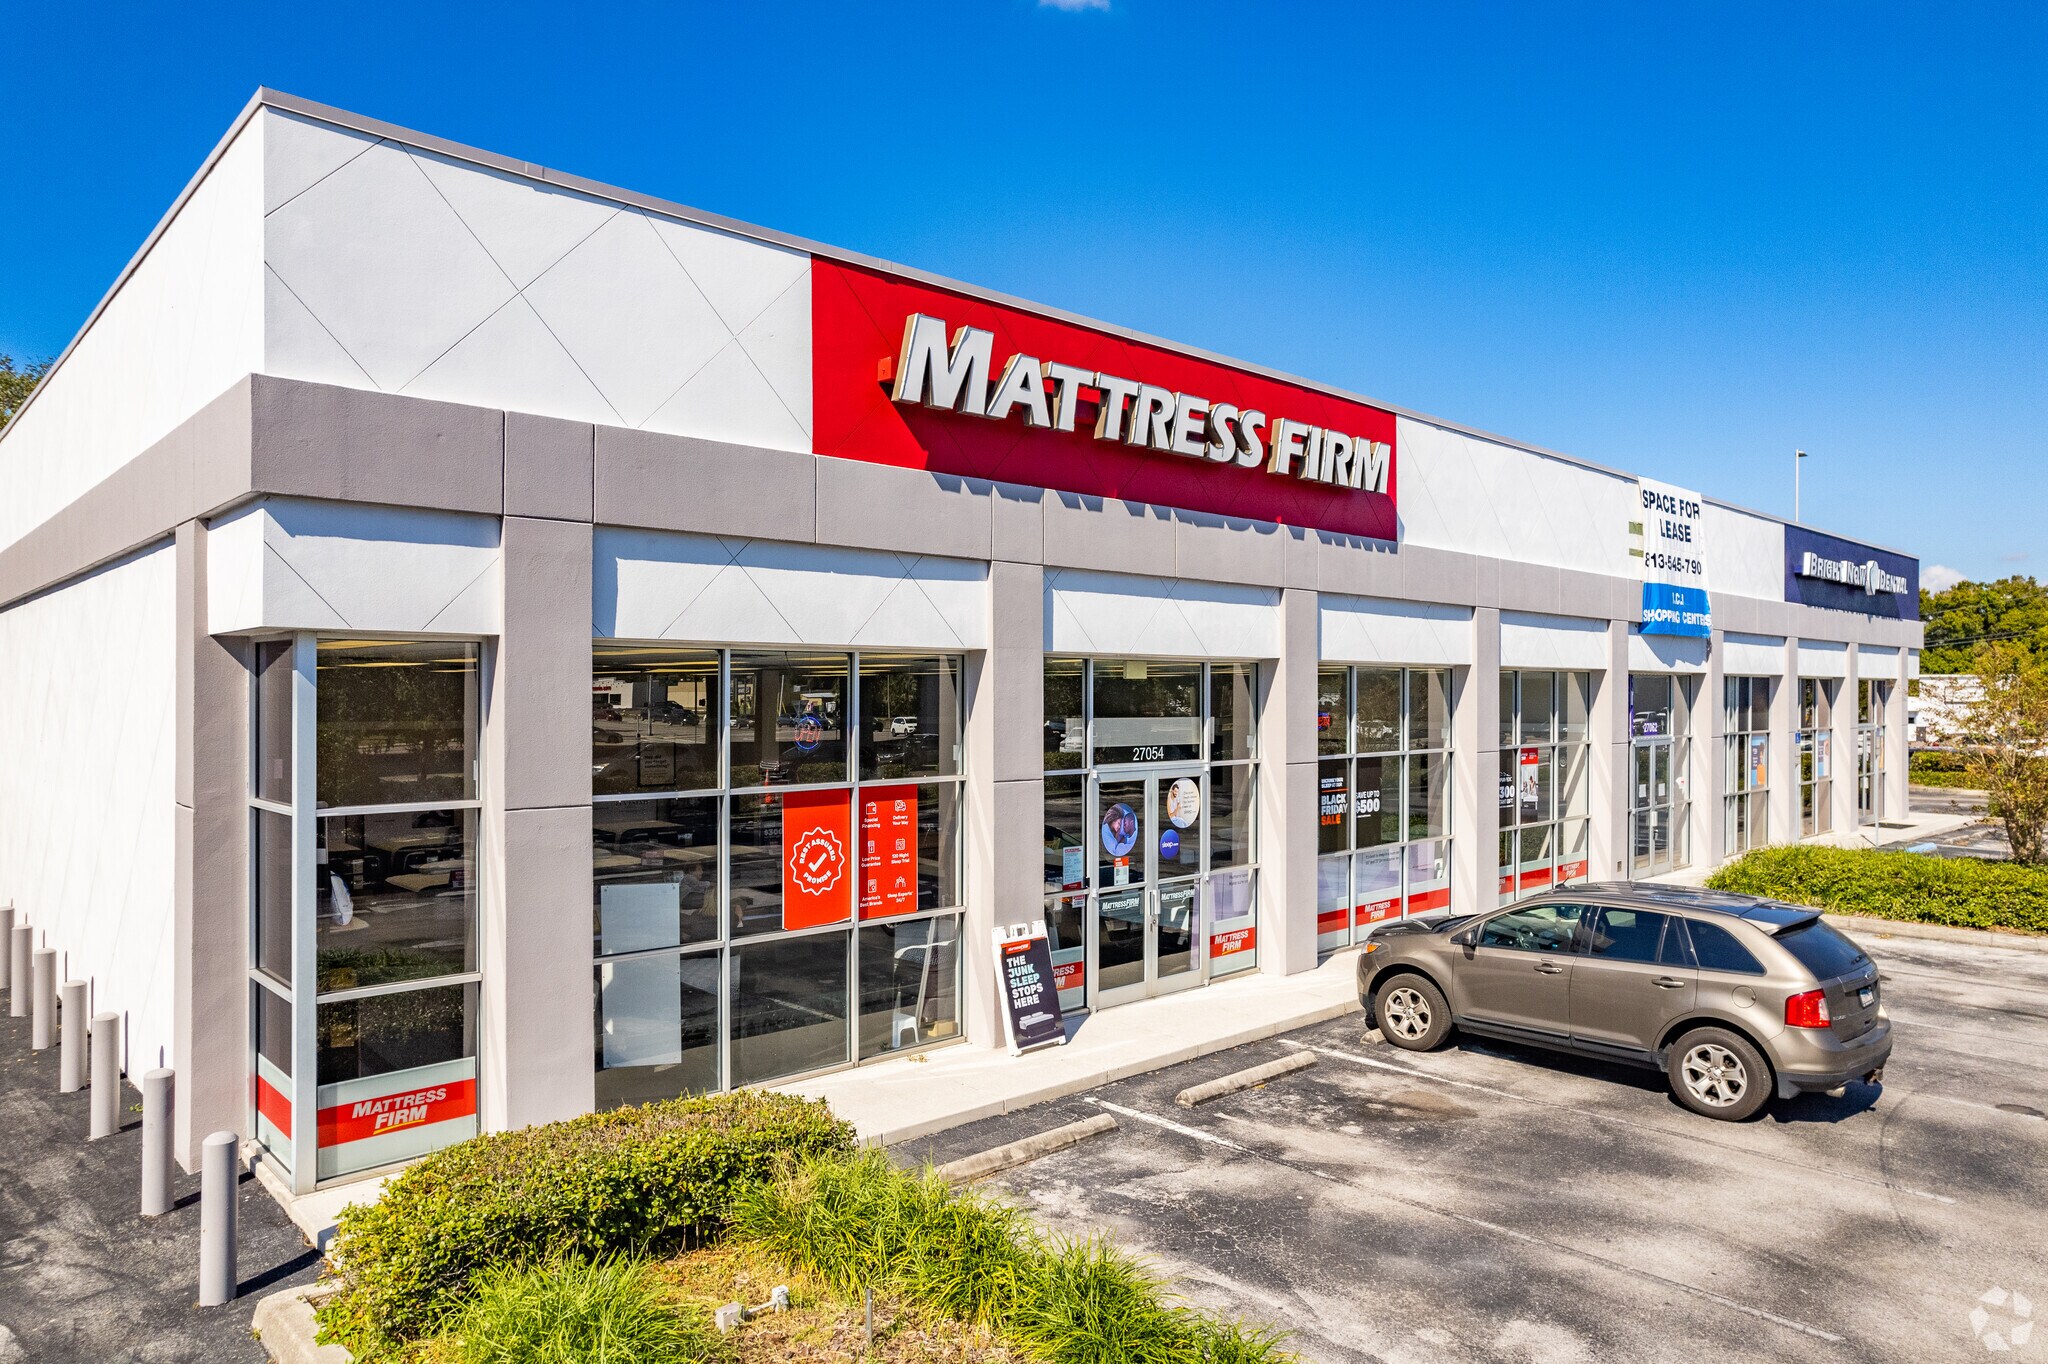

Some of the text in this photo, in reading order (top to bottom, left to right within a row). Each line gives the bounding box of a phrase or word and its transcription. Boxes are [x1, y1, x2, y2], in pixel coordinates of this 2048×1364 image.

[892, 313, 1391, 493] MATTRESS FIRM
[1642, 489, 1700, 519] SPACE FOR
[1660, 519, 1691, 543] LEASE
[1879, 569, 1908, 594] DENTAL
[1643, 722, 1658, 733] 27062
[1133, 746, 1164, 761] 27054
[1374, 790, 1380, 798] TO
[1500, 785, 1515, 799] 300
[1321, 794, 1346, 805] BLACK
[1321, 803, 1348, 816] FRIDAY
[1321, 814, 1341, 826] SALE
[799, 839, 836, 864] REST ASSURED
[803, 870, 832, 884] PROMISE
[1102, 900, 1126, 911] MATTRESS
[1364, 901, 1391, 913] MATTRESS
[1370, 910, 1386, 920] FIRM
[1214, 930, 1249, 945] MATTRESS
[1222, 940, 1242, 953] FIRM
[1006, 955, 1026, 968] THE
[1008, 963, 1035, 978] JUNK
[1053, 965, 1075, 977] RESS
[1010, 973, 1040, 989] SLEEP
[1011, 982, 1044, 999] STOPS
[1013, 994, 1040, 1009] HERE
[352, 1088, 447, 1119] MATTRESS
[374, 1104, 428, 1129] FIRM
